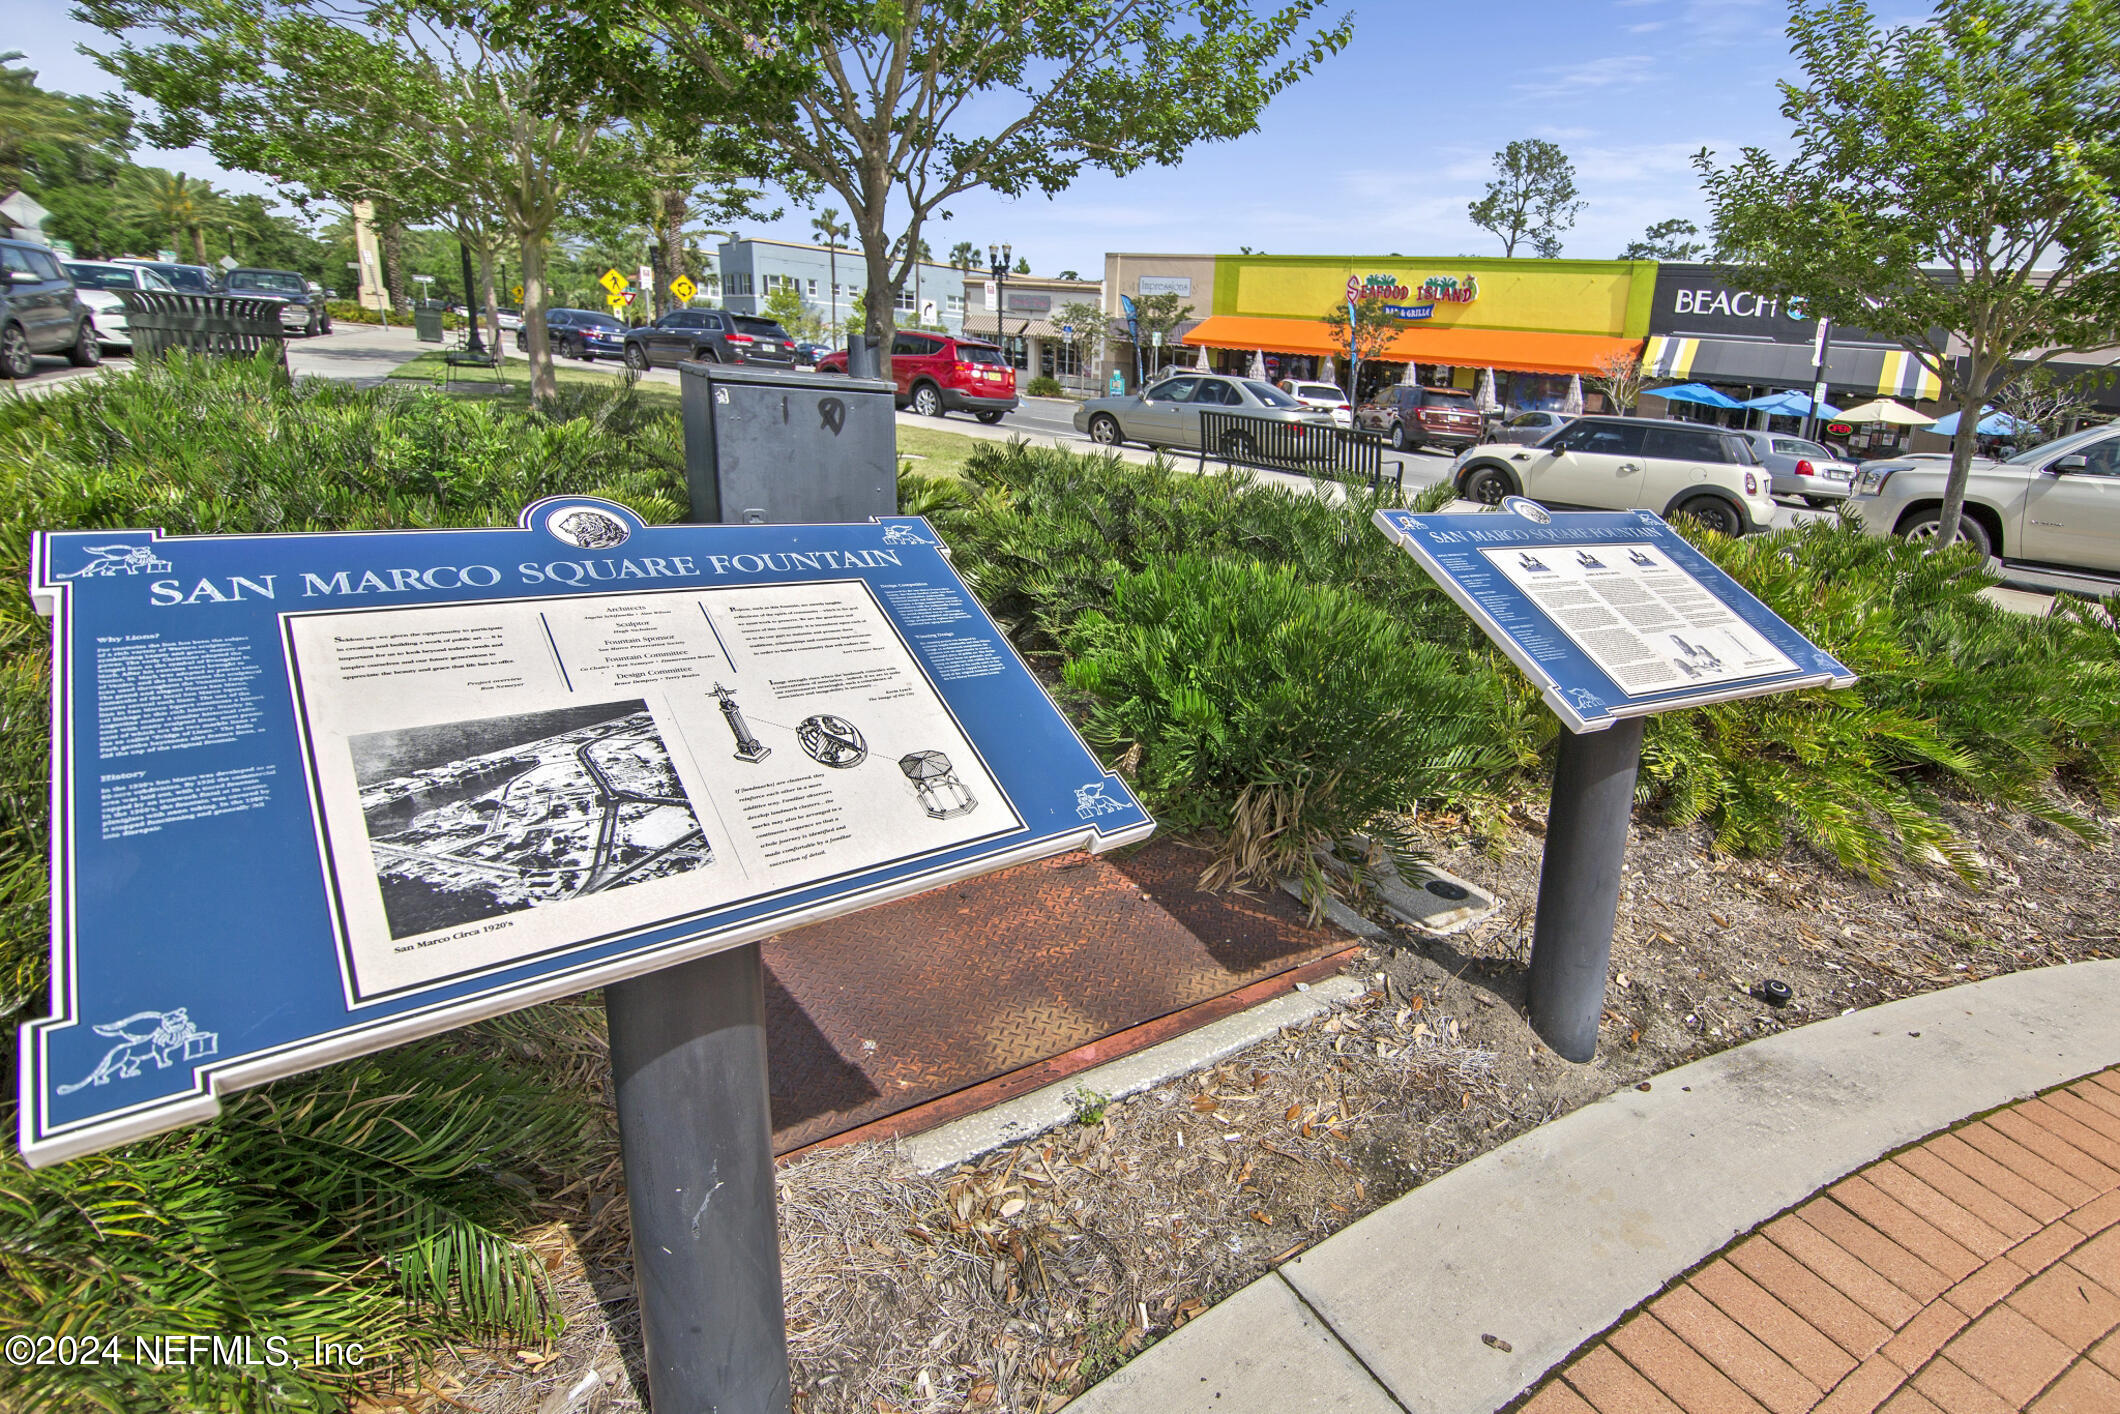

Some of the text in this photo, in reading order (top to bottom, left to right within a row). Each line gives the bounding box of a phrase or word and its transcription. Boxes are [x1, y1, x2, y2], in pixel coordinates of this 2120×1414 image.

[1141, 280, 1188, 292] Impressions
[1346, 274, 1472, 304] SEAFOOD ISLAND
[1674, 289, 1778, 318] BEACH
[1828, 424, 1852, 434] OPEN
[1429, 528, 1664, 544] SAN MARCO SQUARE FOUNTAIN
[149, 549, 902, 606] SAN MARCO SQUARE FOUNTAIN
[125, 633, 160, 641] Lions?
[604, 654, 642, 663] Fountain
[647, 667, 692, 675] Committee
[100, 771, 146, 782] History
[394, 921, 513, 954] San Marco Circa 1920's
